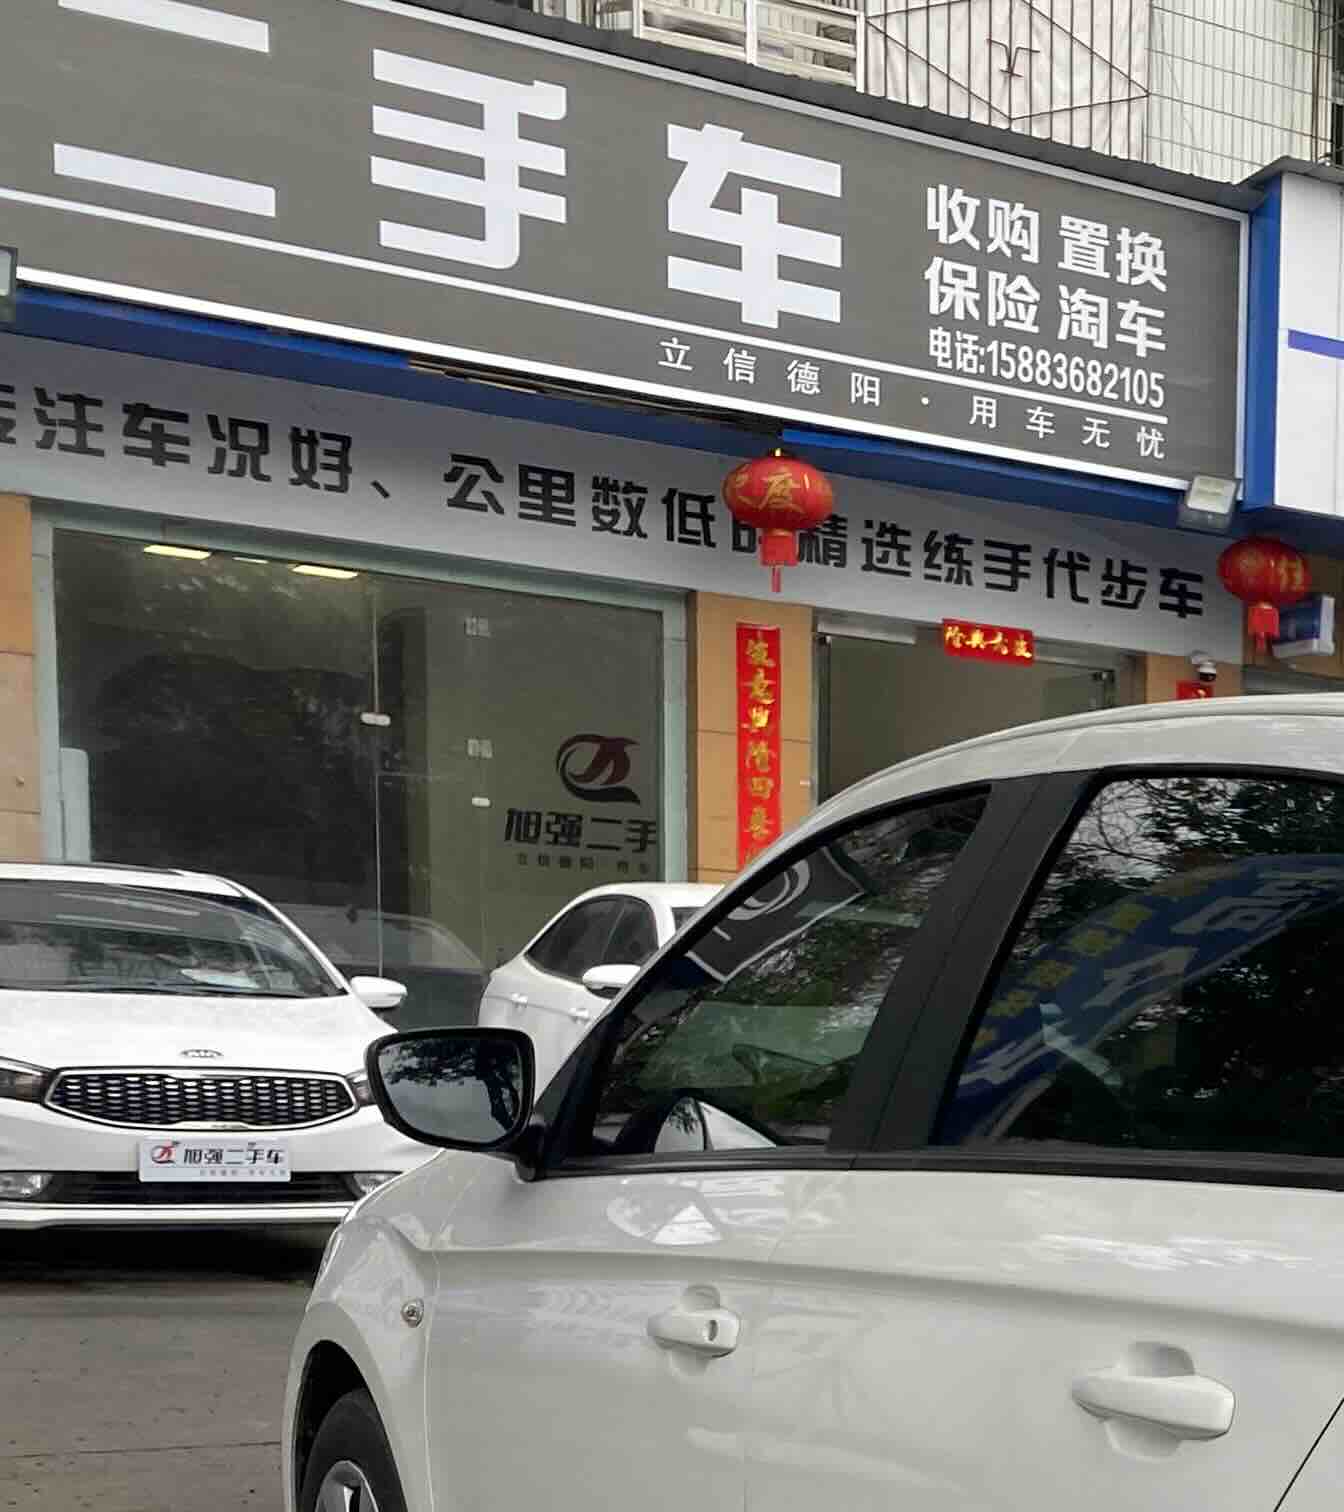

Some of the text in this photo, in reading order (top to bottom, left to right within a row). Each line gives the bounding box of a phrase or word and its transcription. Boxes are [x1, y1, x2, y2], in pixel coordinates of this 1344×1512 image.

[54, 0, 841, 329] 二手车
[926, 183, 1168, 292] 收购 置换
[924, 255, 1167, 358] 保险 淘车
[928, 326, 1165, 409] 电话:15883682105
[0, 383, 1204, 619] 注车况好、公里数低精选练手代步车
